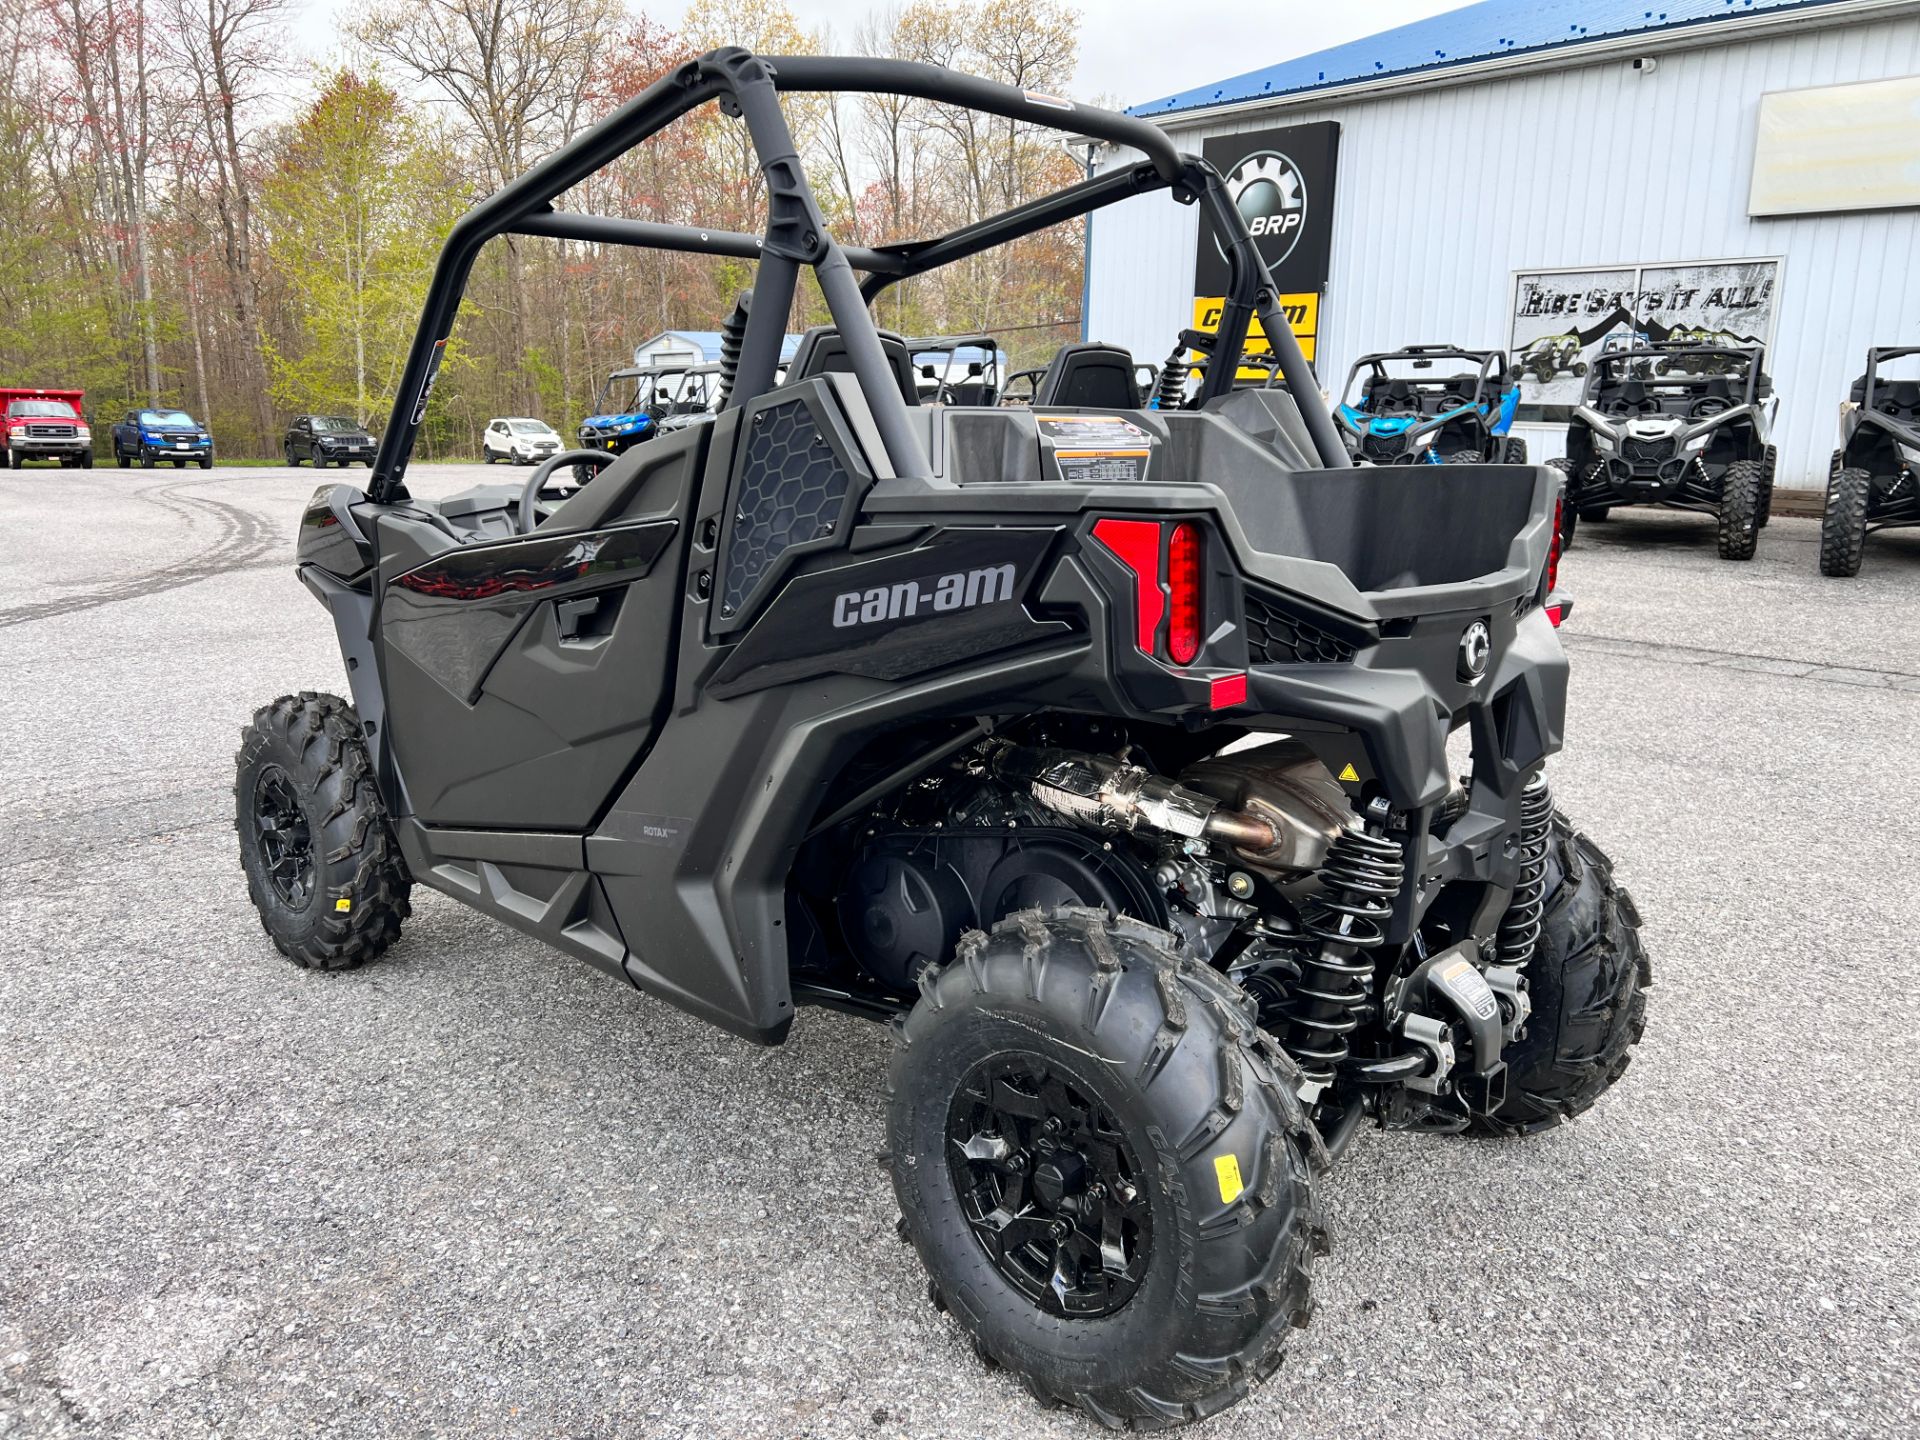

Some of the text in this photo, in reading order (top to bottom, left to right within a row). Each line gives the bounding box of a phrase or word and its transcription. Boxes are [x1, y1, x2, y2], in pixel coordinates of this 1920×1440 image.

[1250, 213, 1300, 236] BRP
[832, 563, 1016, 628] can-am
[643, 826, 668, 838] ROTAX
